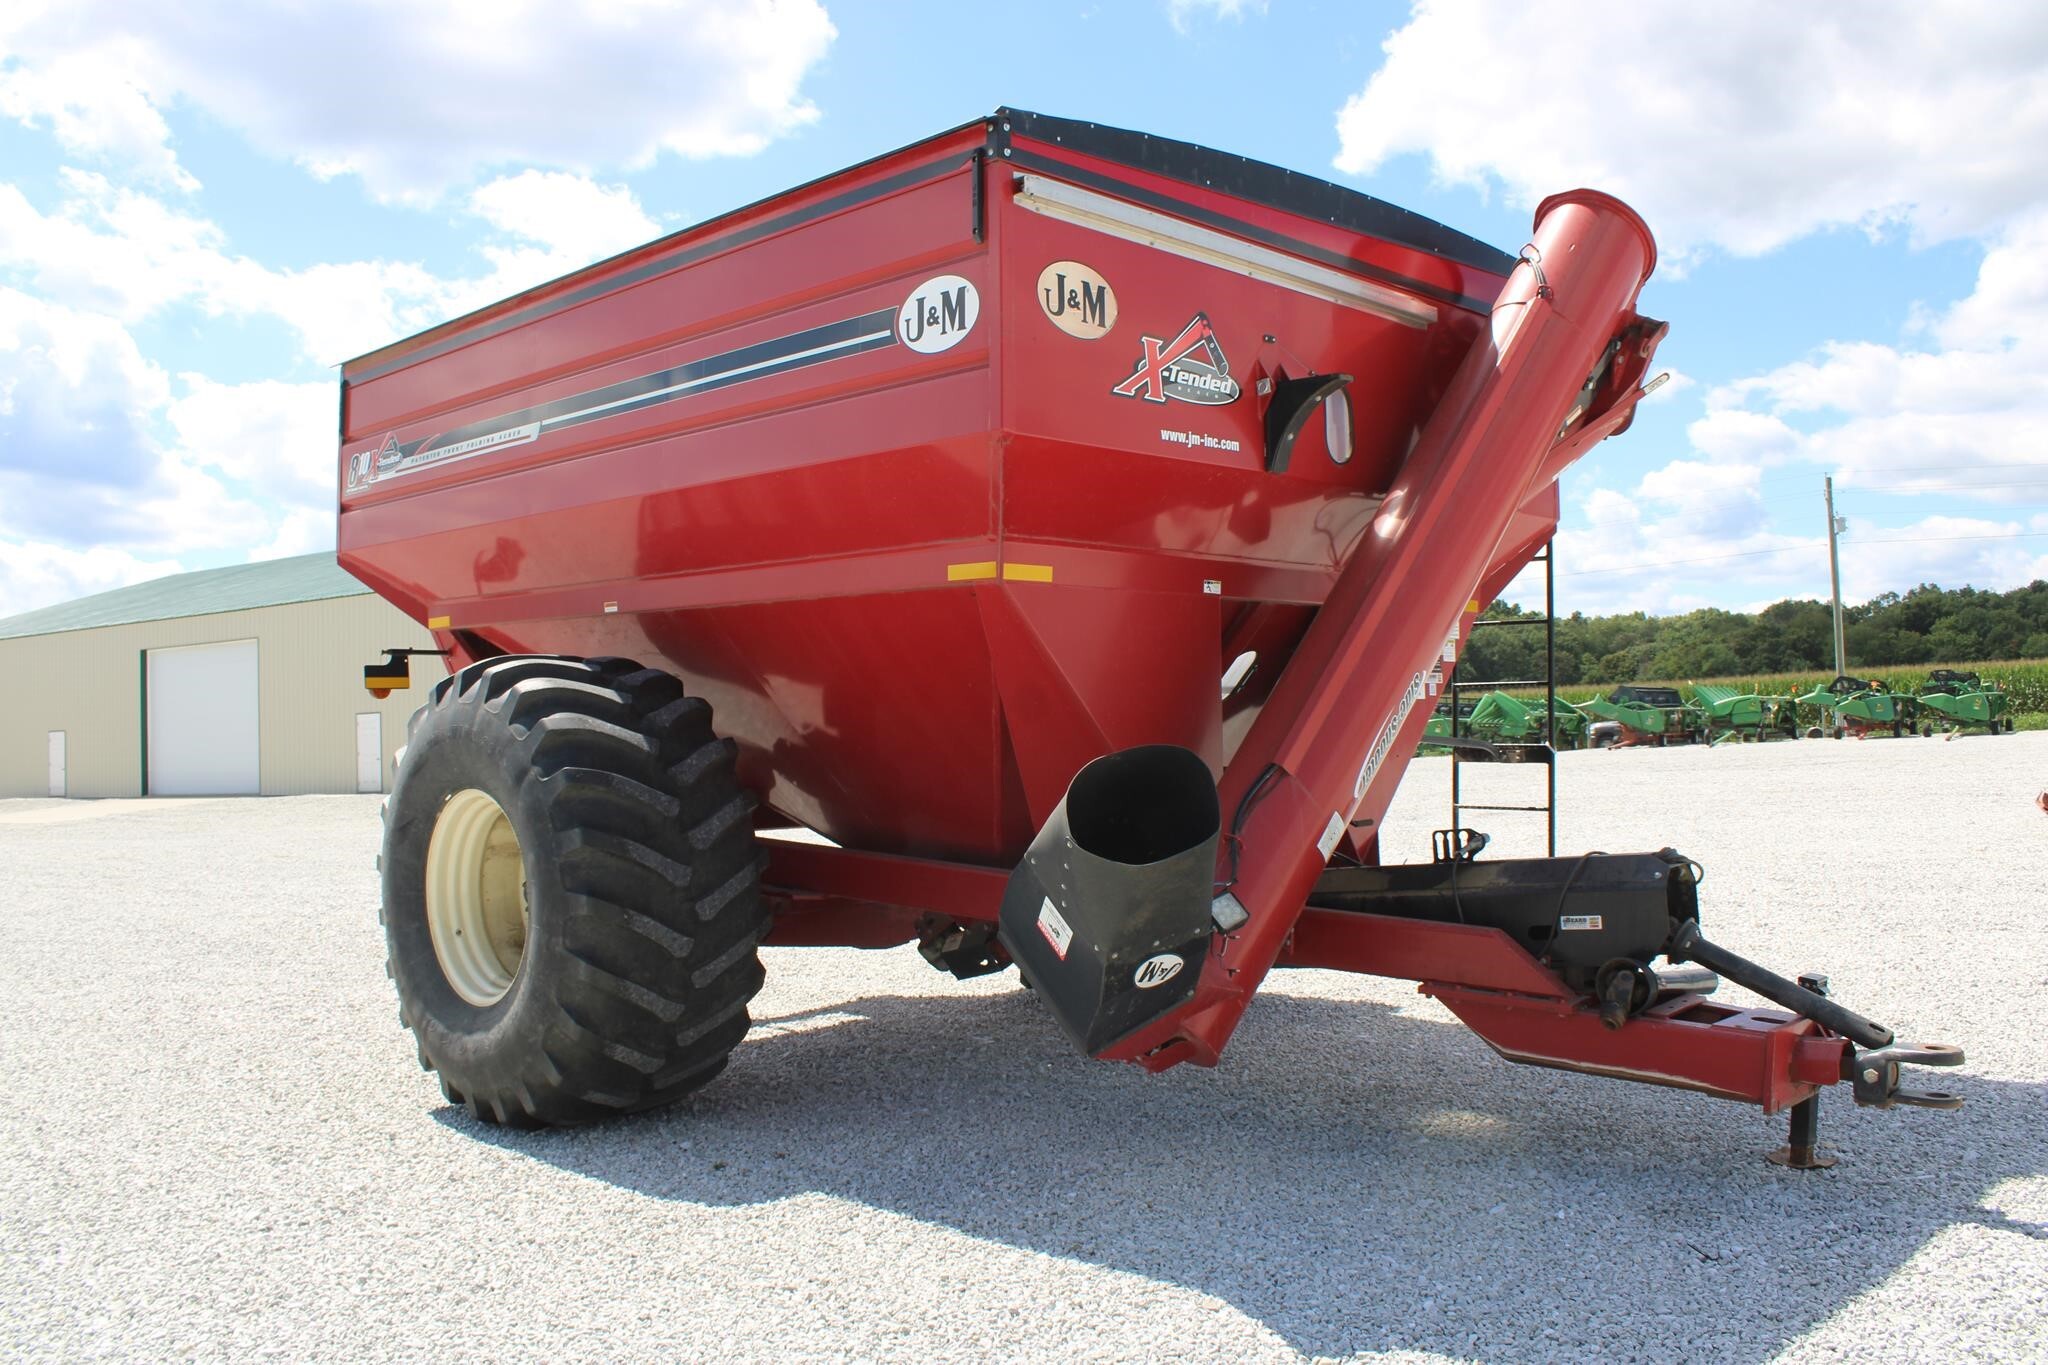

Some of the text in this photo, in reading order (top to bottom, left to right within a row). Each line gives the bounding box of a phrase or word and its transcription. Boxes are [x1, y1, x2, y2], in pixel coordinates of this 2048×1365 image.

[905, 285, 968, 342] J&M
[1044, 272, 1107, 329] J&M
[1160, 429, 1240, 452] www.jm-inc.com
